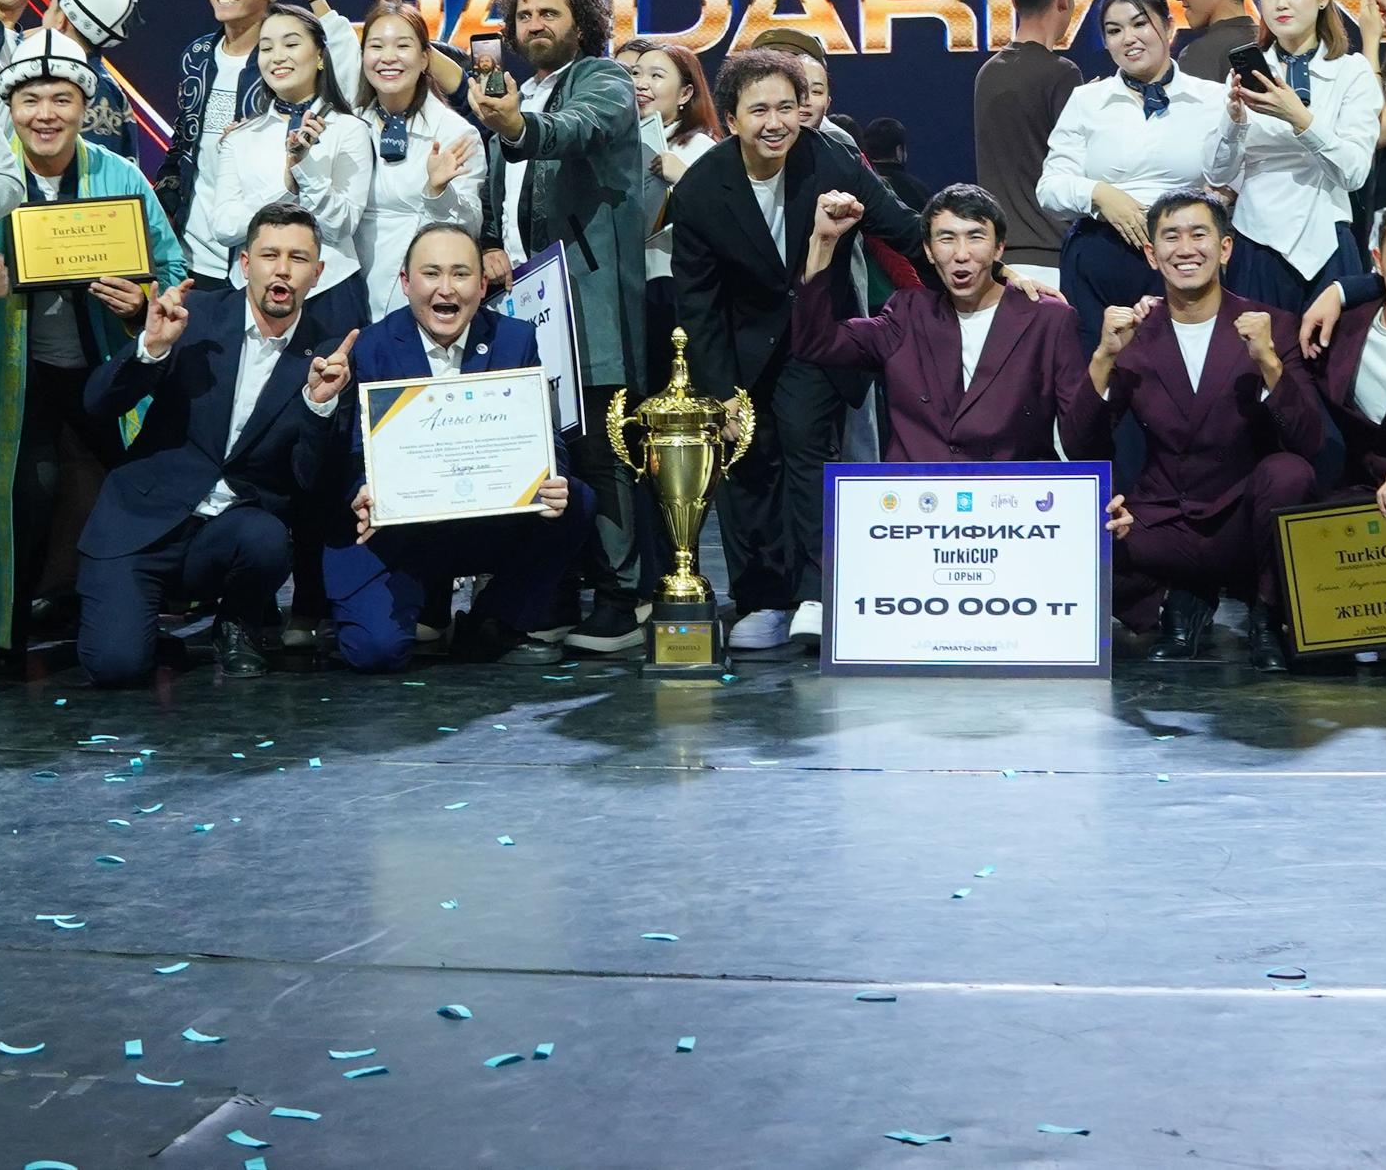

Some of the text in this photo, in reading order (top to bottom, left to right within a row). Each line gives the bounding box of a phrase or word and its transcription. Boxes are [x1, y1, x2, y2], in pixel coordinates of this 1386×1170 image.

[51, 224, 107, 236] TurkiCUP
[68, 253, 108, 264] ОРЫН
[869, 524, 1061, 539] СЕРТИФИКАТ
[933, 548, 999, 564] TurkiCUP
[954, 571, 982, 581] ОРЫН
[958, 597, 1037, 615] 000
